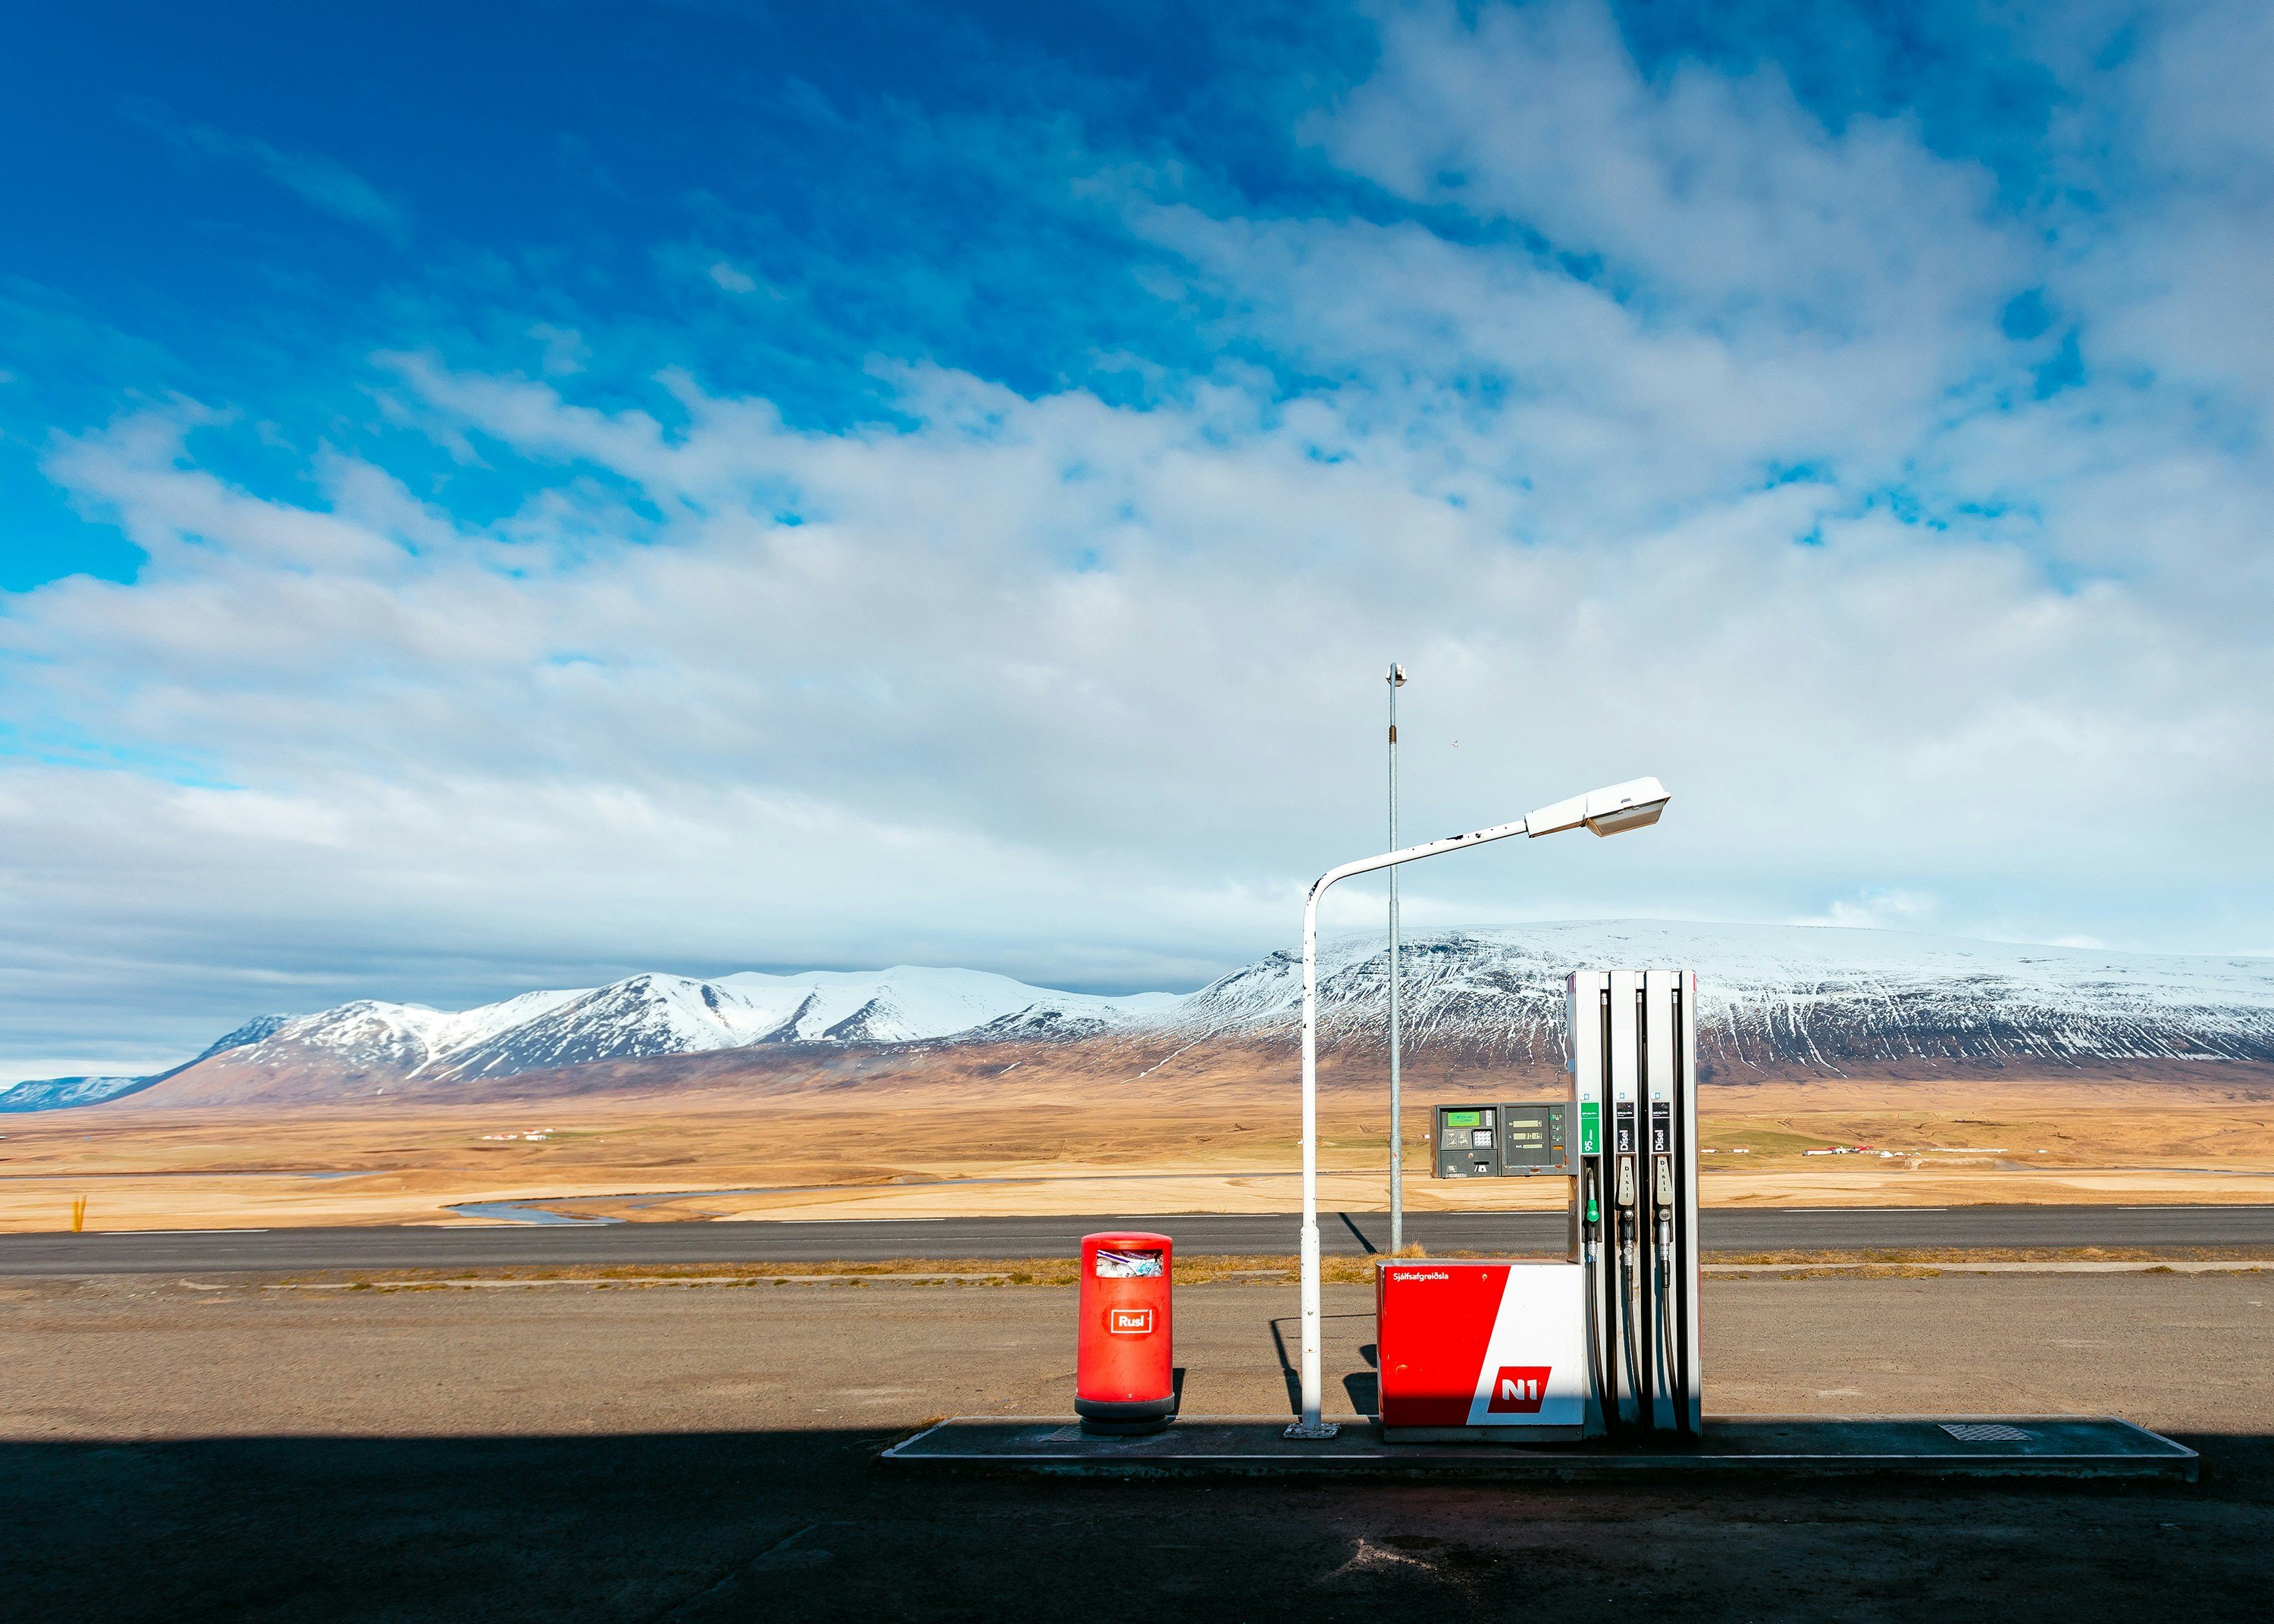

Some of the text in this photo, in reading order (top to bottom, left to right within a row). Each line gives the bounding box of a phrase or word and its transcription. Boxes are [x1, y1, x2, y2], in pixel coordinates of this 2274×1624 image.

[1584, 1141, 1593, 1152] 95
[1619, 1130, 1629, 1151] Dísel
[1654, 1130, 1665, 1151] Dísel
[1392, 1272, 1449, 1282] Sjálfsafgreiðsla
[1119, 1315, 1145, 1327] Rusl
[1502, 1378, 1537, 1400] N1
